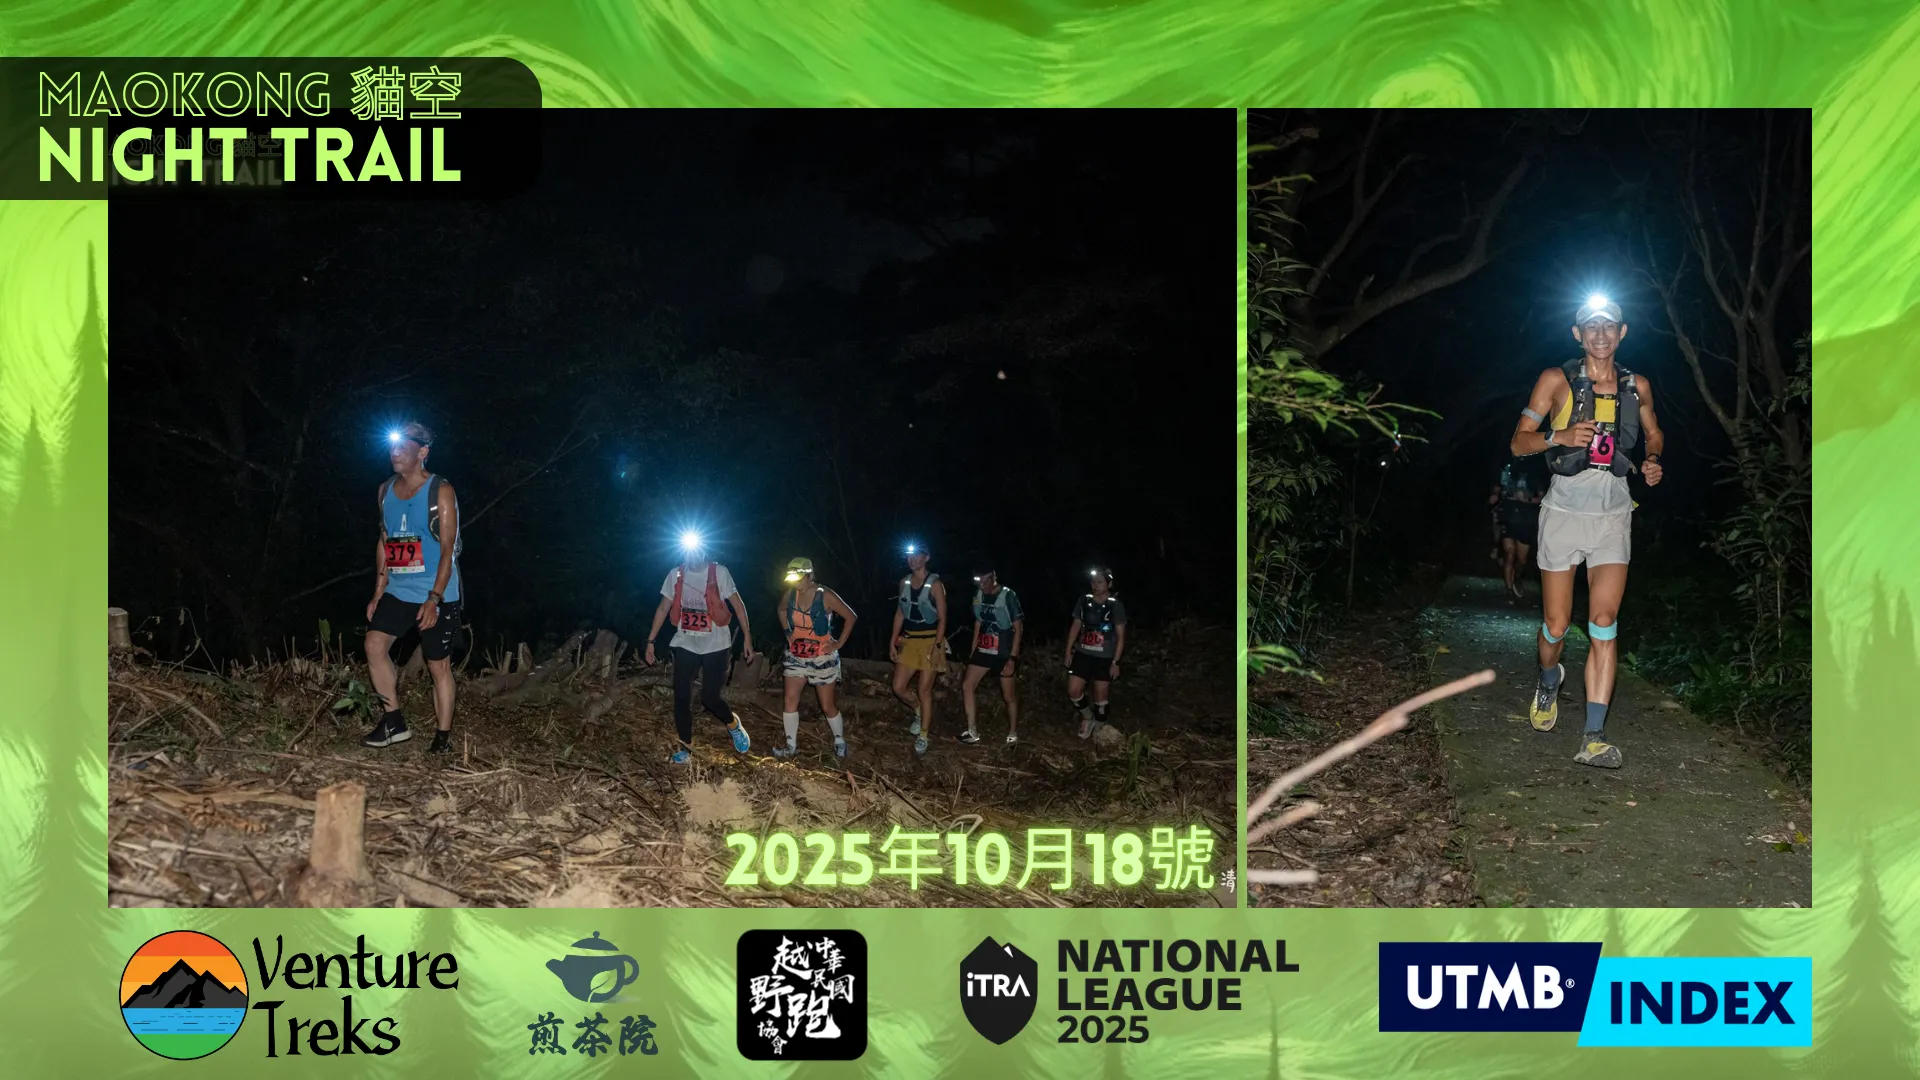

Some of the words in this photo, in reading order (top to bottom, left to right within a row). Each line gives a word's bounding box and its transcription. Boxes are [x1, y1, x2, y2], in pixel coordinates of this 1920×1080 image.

[388, 544, 416, 561] 379
[683, 613, 708, 628] 325
[792, 643, 815, 655] 324
